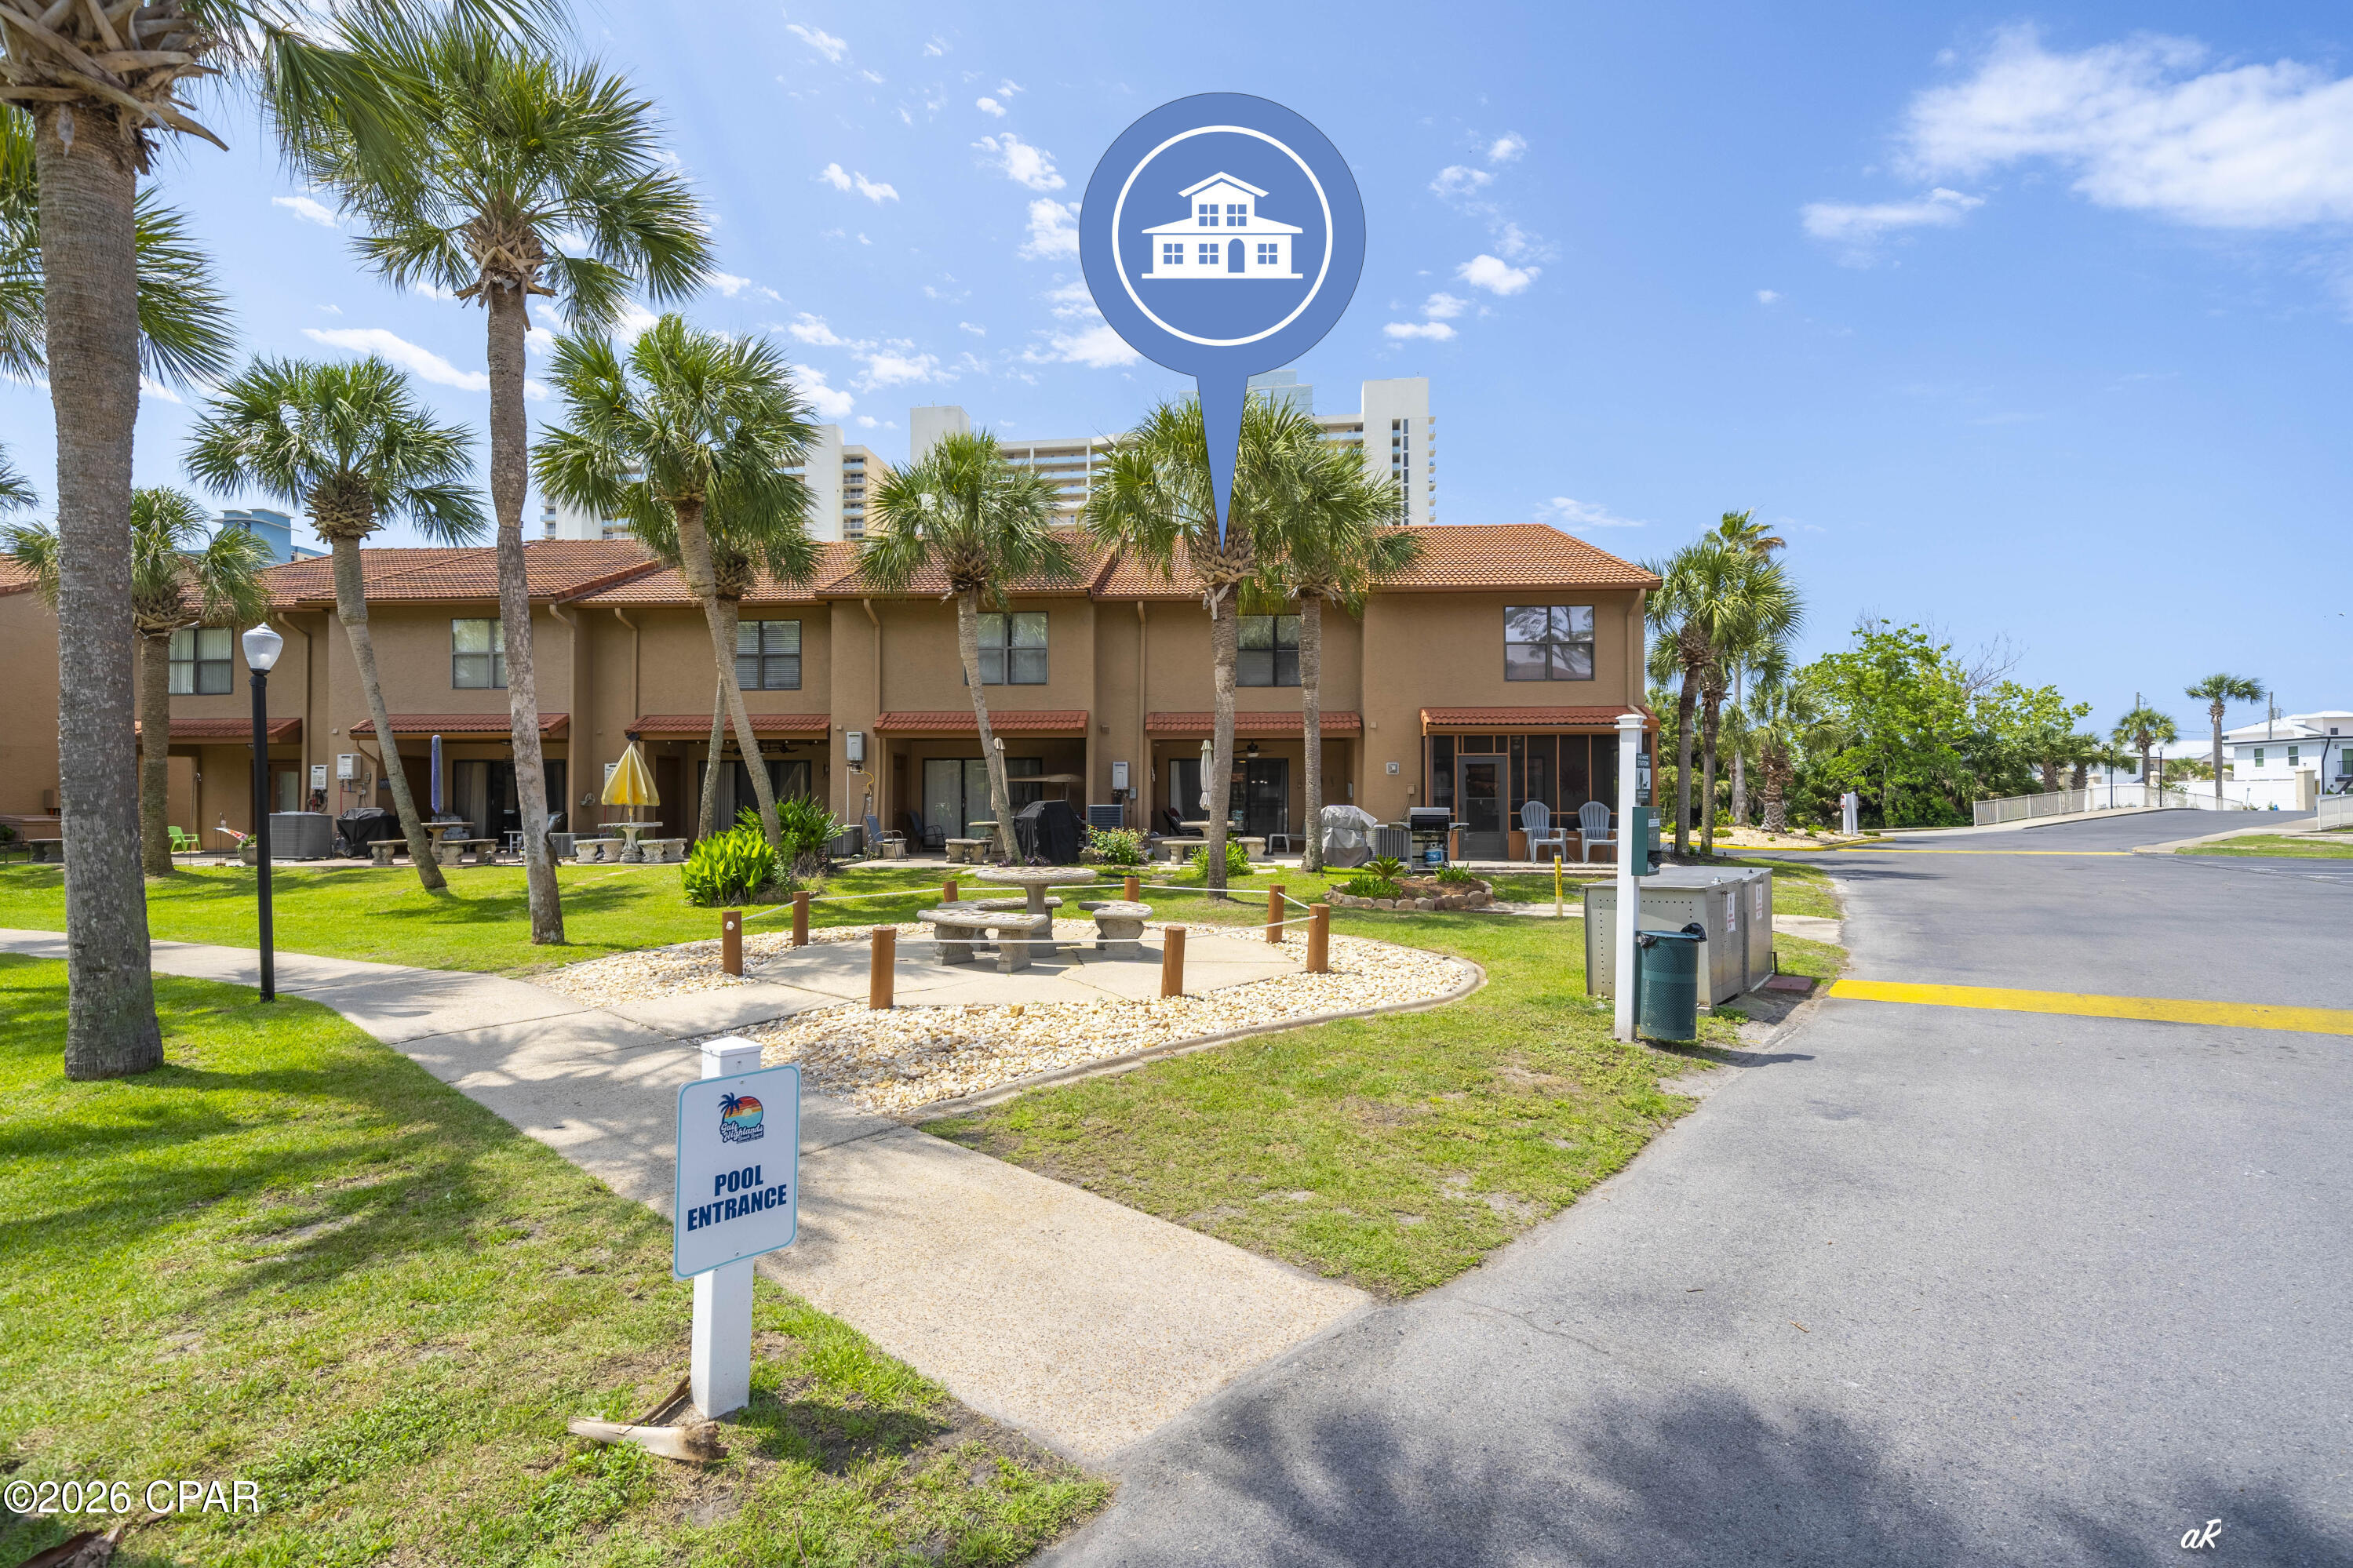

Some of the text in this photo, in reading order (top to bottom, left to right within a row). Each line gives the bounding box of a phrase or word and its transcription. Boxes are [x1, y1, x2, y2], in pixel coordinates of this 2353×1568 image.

[720, 1122, 738, 1134] Gulf
[723, 1124, 763, 1142] Highlands
[714, 1164, 764, 1197] POOL
[687, 1184, 787, 1232] ENTRANCE
